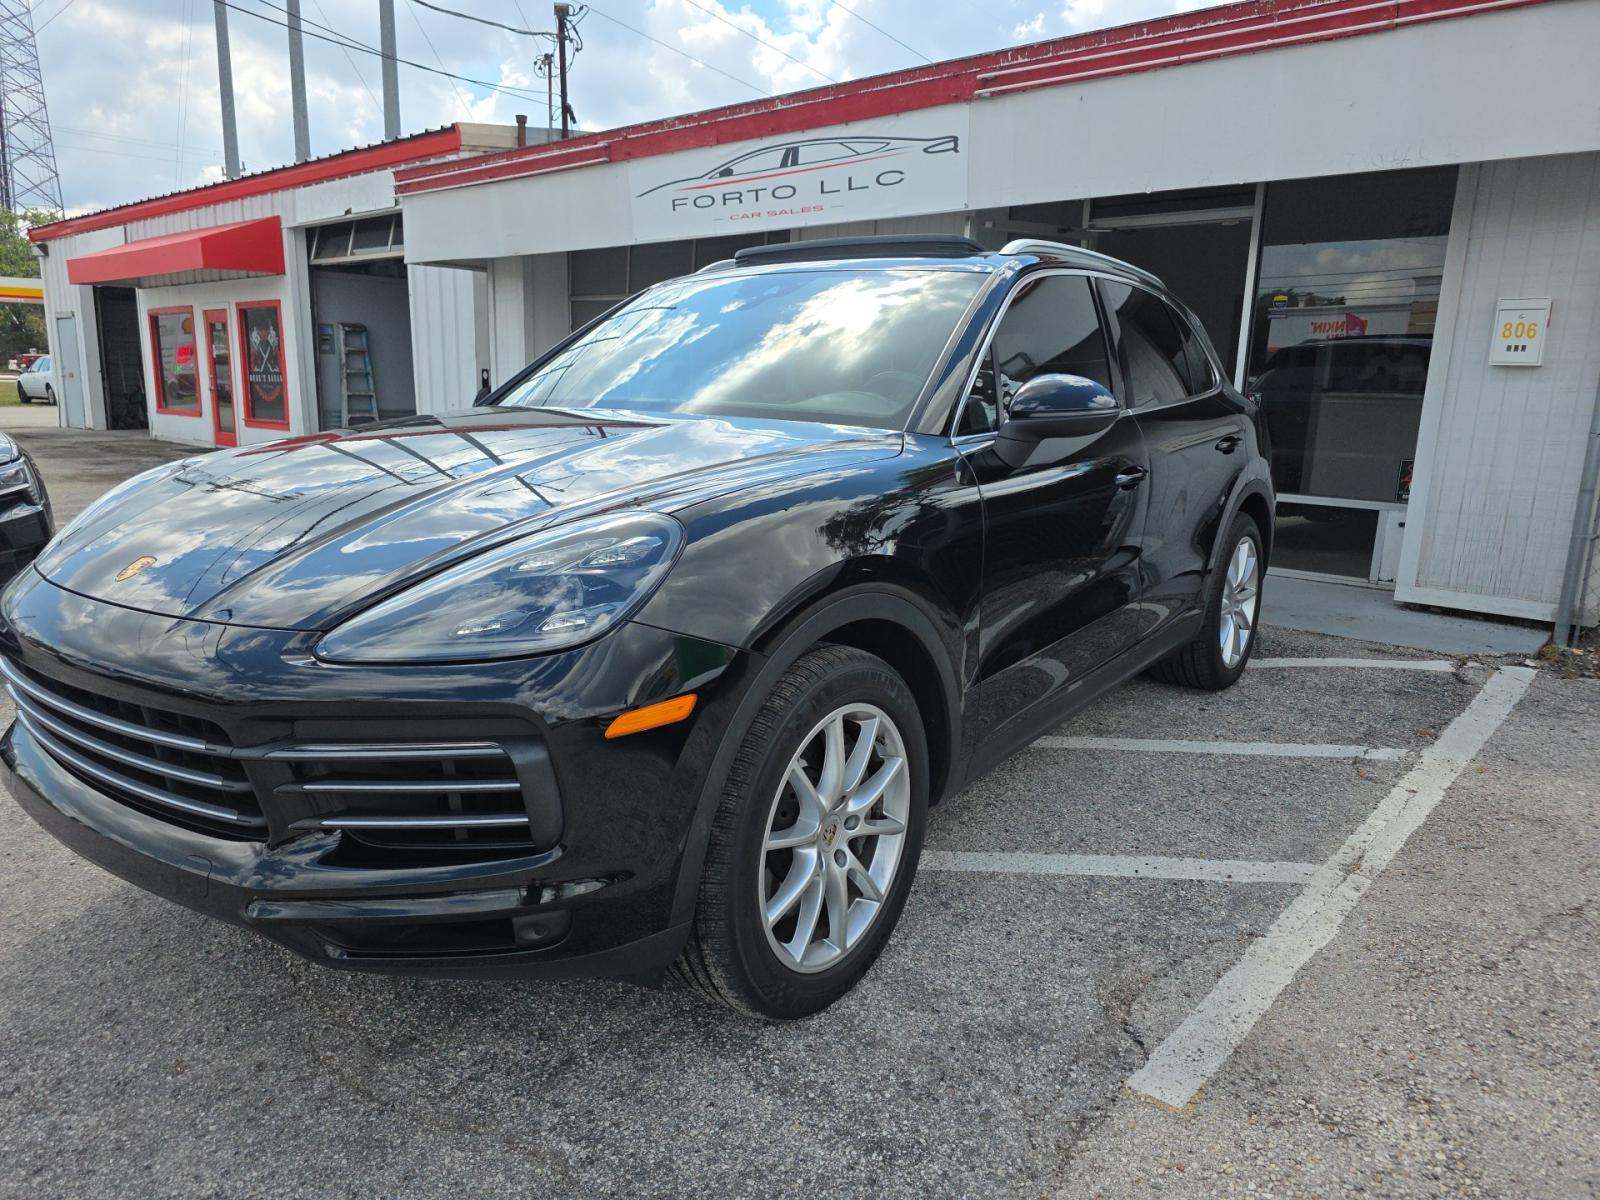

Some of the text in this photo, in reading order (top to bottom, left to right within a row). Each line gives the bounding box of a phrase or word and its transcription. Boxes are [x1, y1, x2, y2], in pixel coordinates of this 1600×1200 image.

[672, 170, 905, 211] FORTO LLC
[729, 206, 825, 221] CAR SALES
[1502, 321, 1537, 340] 806
